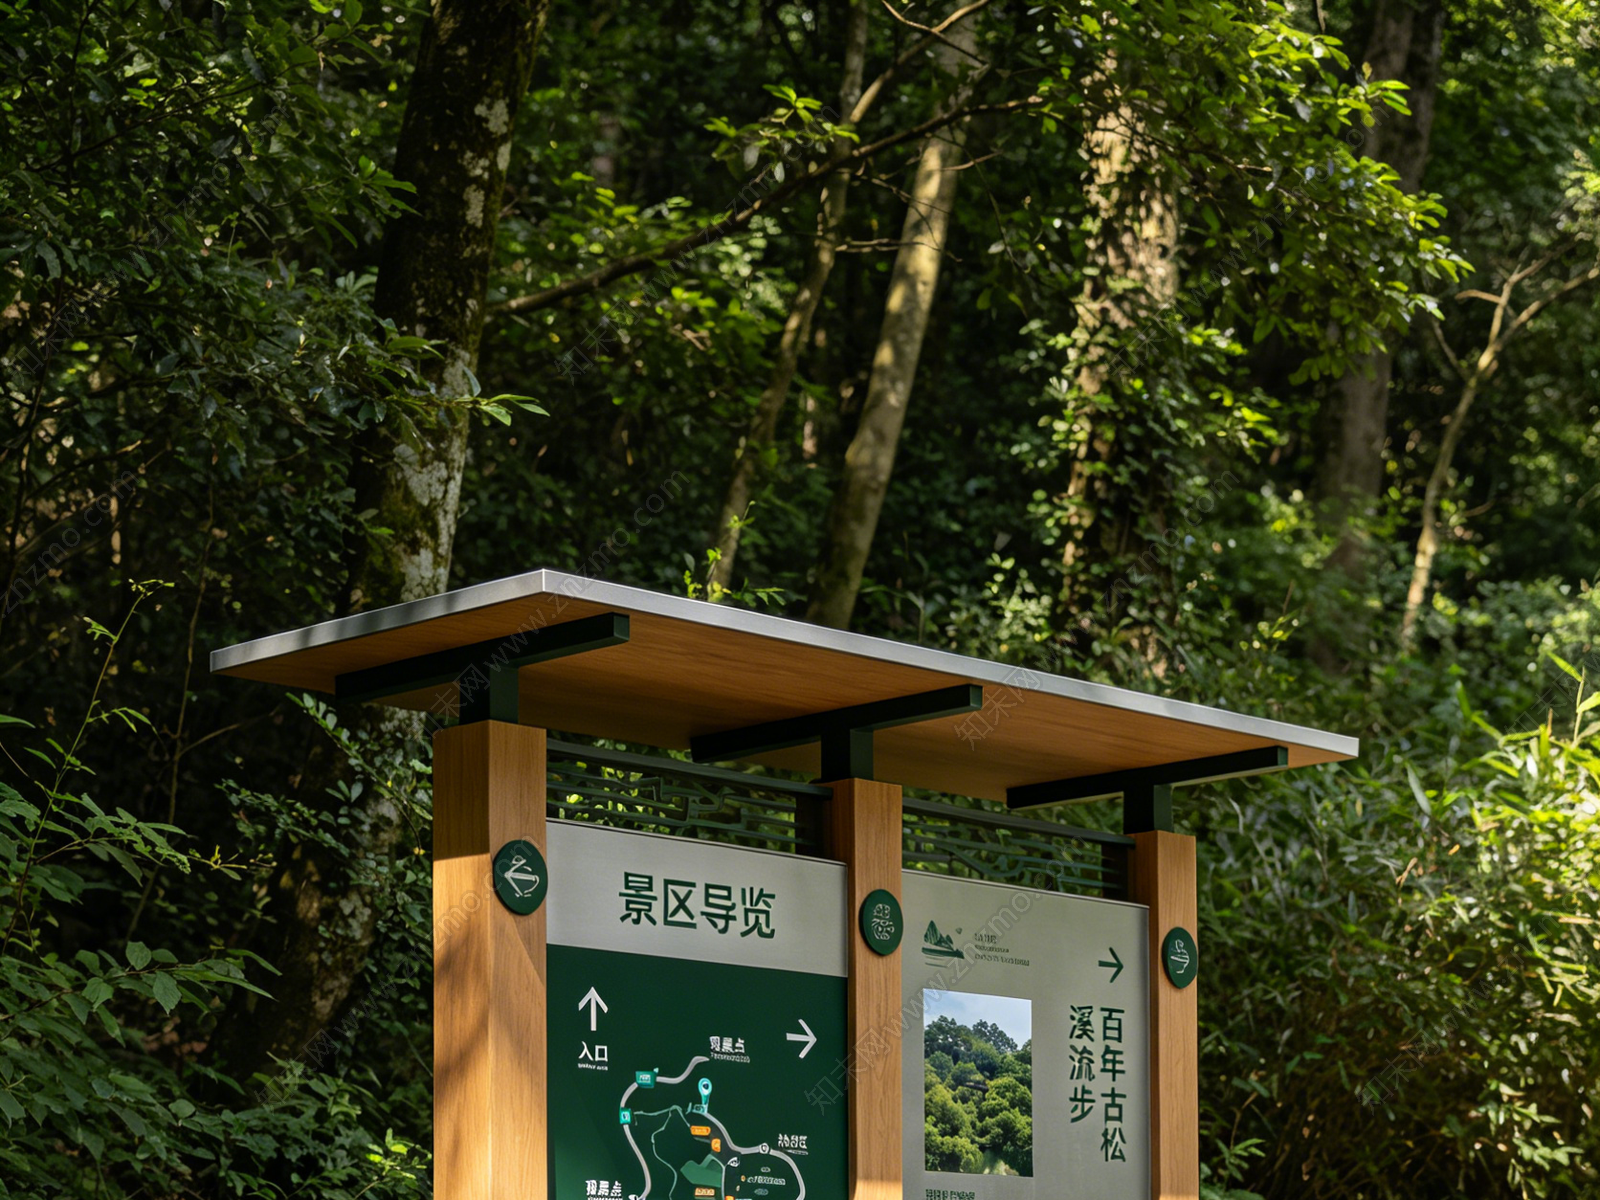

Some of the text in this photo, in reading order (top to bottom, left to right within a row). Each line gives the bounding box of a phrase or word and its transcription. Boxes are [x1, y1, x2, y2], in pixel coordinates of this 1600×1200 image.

[618, 871, 776, 939] 景区导览
[578, 1041, 608, 1062] 入口
[1069, 1005, 1096, 1123] 溪流步
[1100, 1007, 1127, 1162] 百年古松
